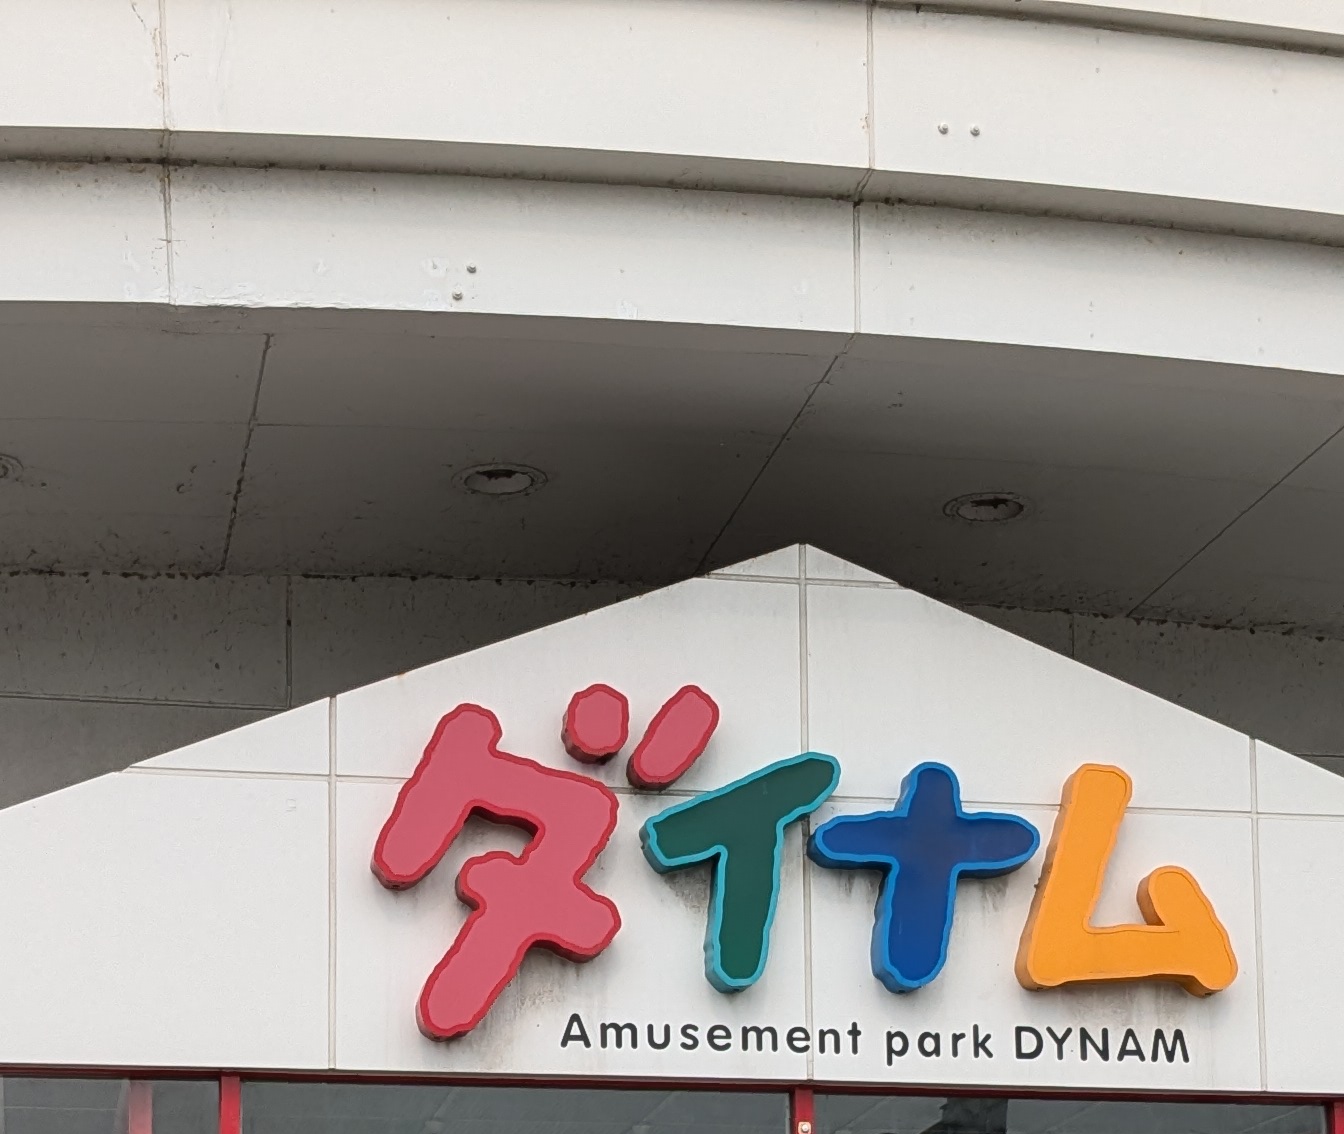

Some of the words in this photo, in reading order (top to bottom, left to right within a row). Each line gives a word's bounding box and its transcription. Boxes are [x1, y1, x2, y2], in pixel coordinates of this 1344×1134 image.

[371, 684, 1238, 1042] ダイナム
[559, 1012, 862, 1056] Amusement
[885, 1020, 994, 1066] park
[1013, 1025, 1191, 1063] DYNAM
